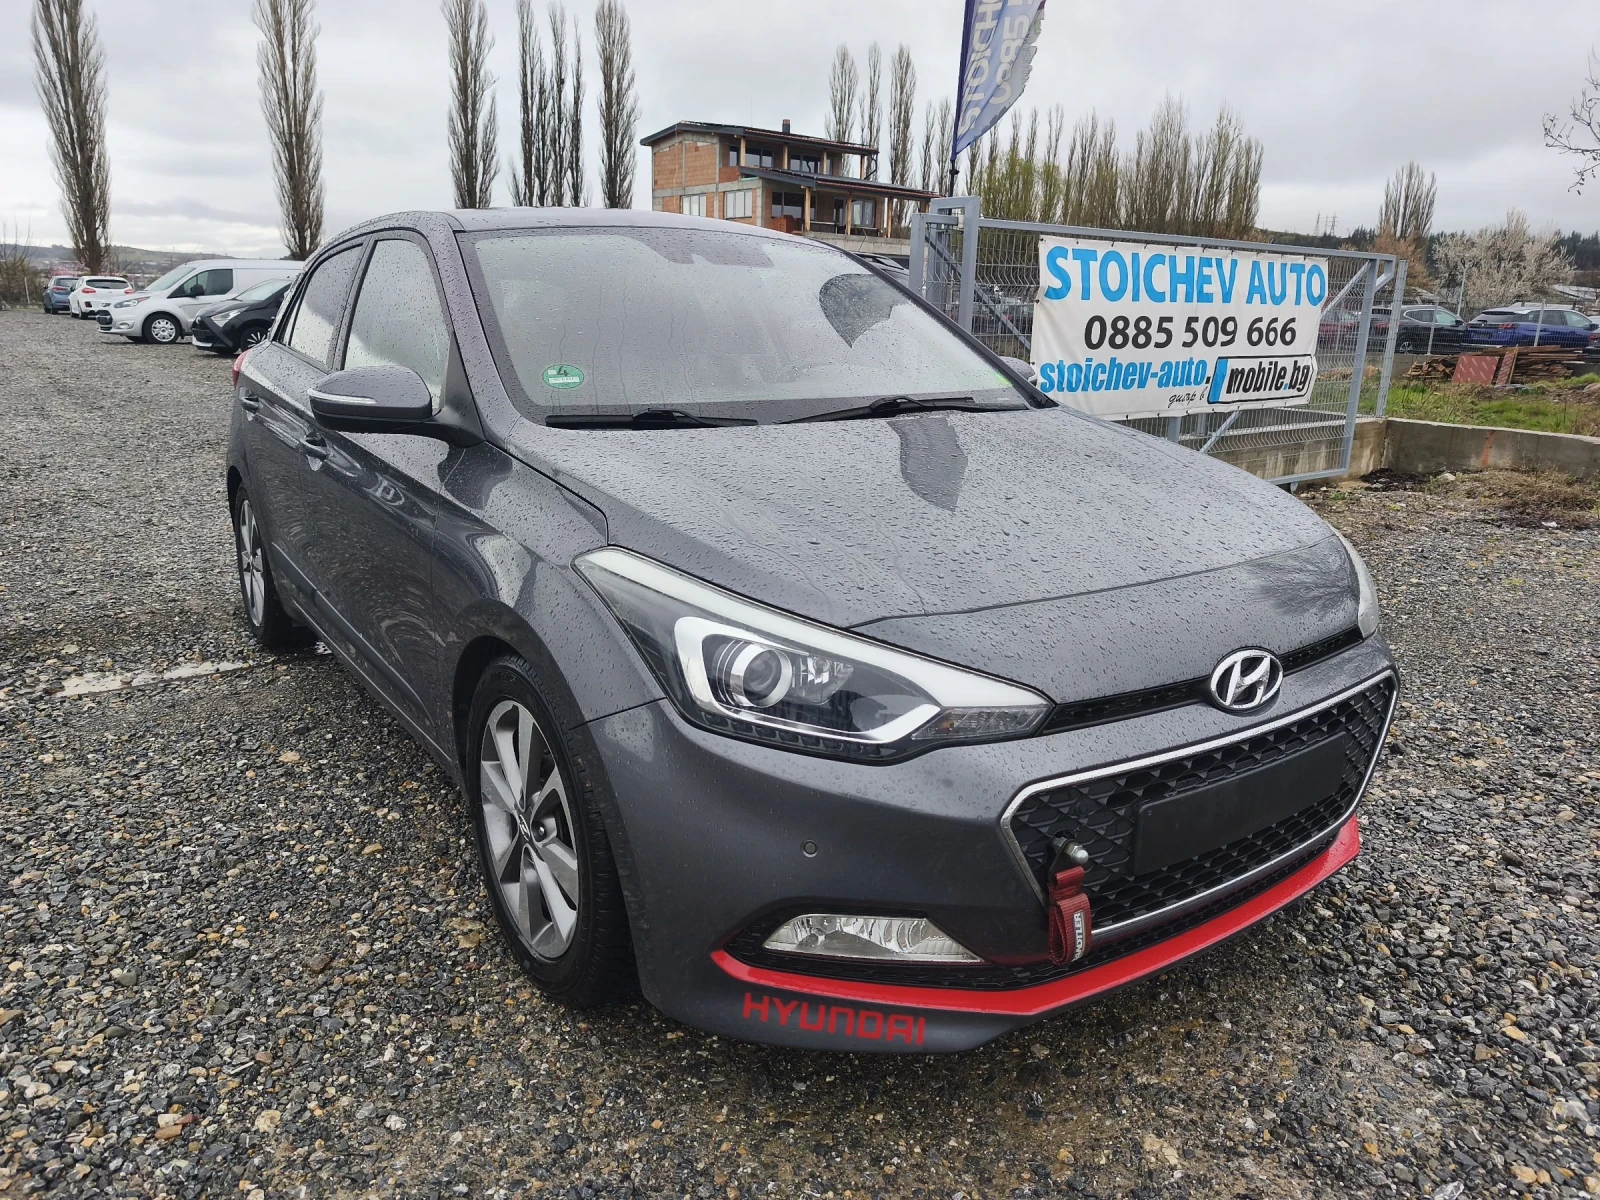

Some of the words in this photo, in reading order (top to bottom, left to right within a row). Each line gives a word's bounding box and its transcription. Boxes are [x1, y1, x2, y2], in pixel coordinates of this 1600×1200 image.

[958, 0, 1003, 136] STOICH
[1044, 246, 1238, 304] STOICHEV
[1246, 260, 1326, 307] AUTO
[1084, 315, 1173, 350] 0885
[1182, 317, 1238, 348] 509
[1247, 317, 1297, 347] 666
[557, 366, 568, 377] 4
[1226, 360, 1310, 393] mobile.bg
[742, 992, 926, 1045] HYUNDAI
